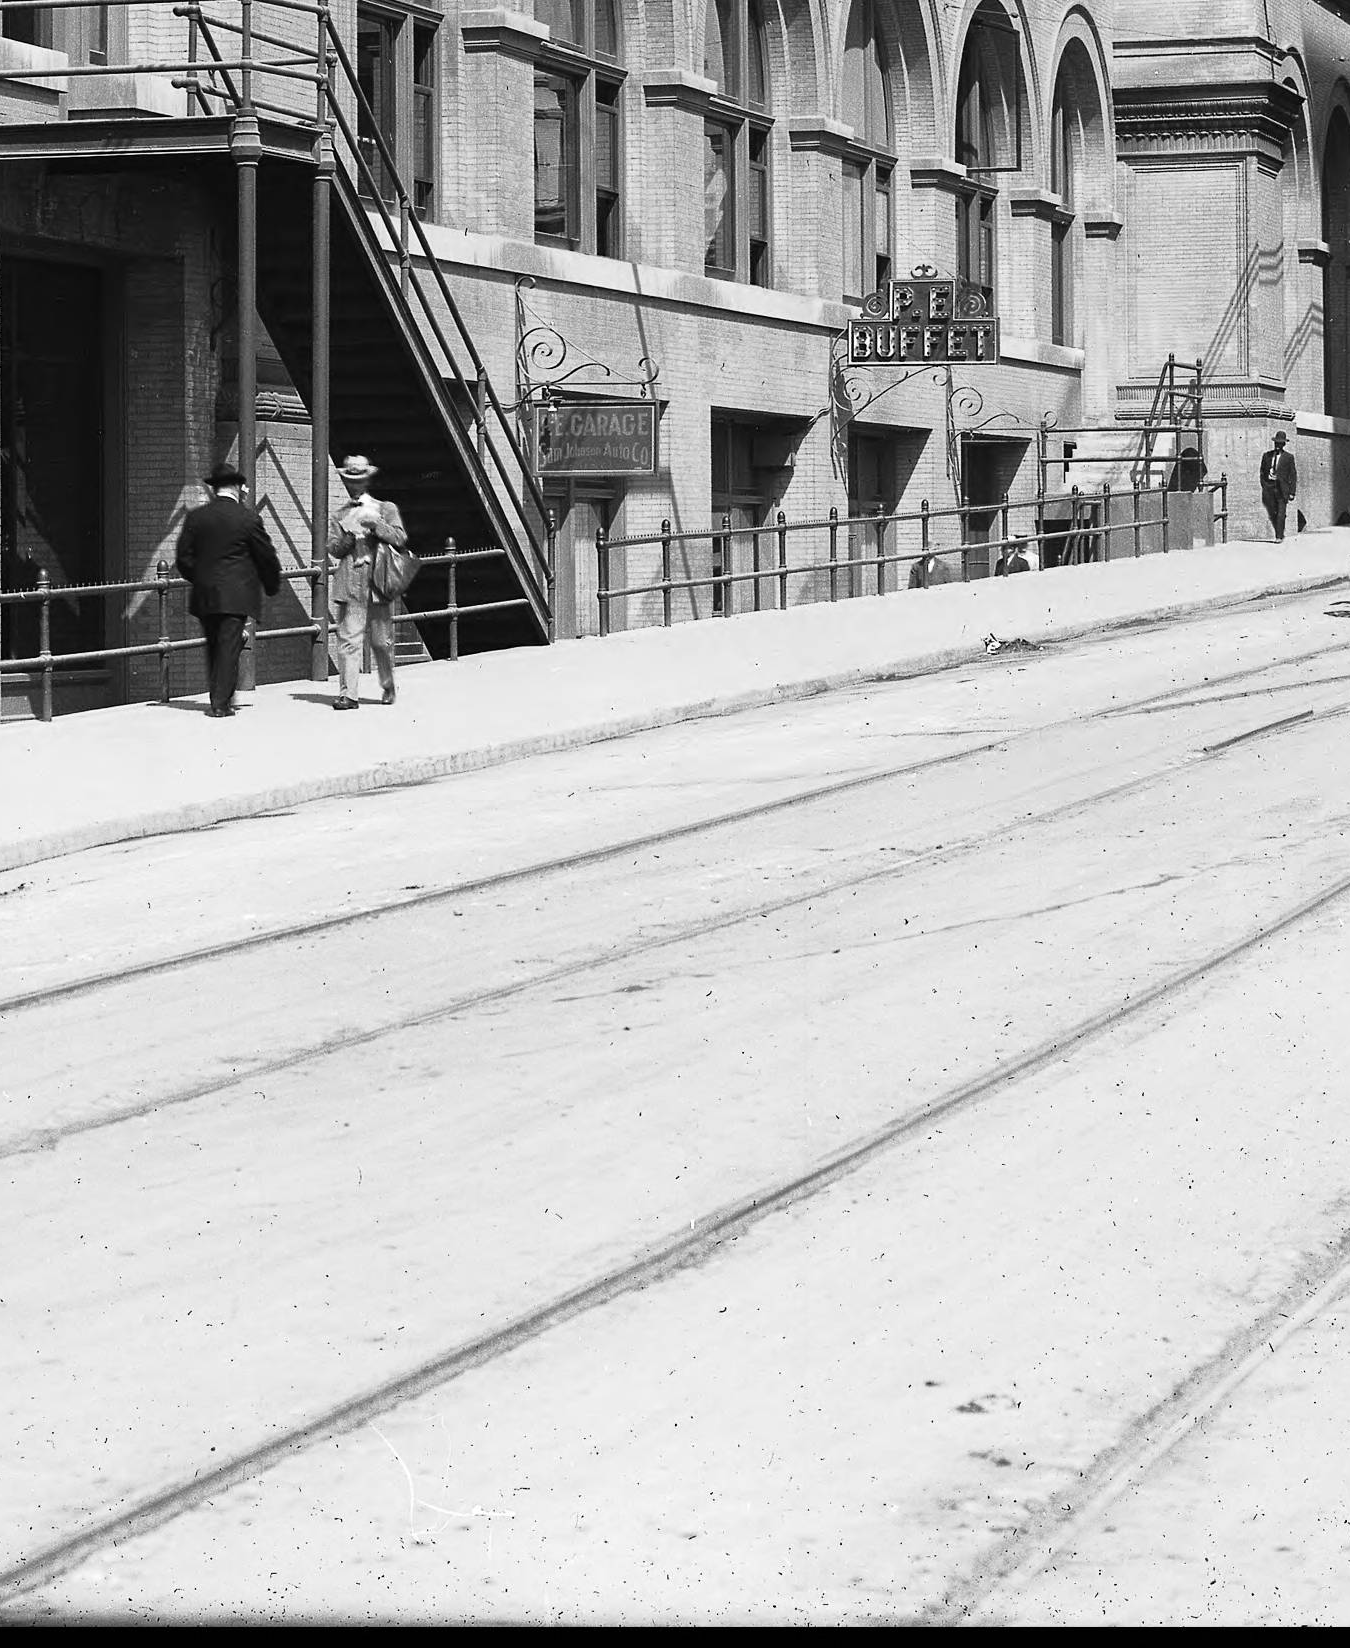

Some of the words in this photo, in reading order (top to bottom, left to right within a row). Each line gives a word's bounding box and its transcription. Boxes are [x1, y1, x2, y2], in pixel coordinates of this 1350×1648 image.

[853, 324, 992, 358] BUFFET
[570, 411, 649, 437] GARAGE
[603, 441, 630, 460] Auto
